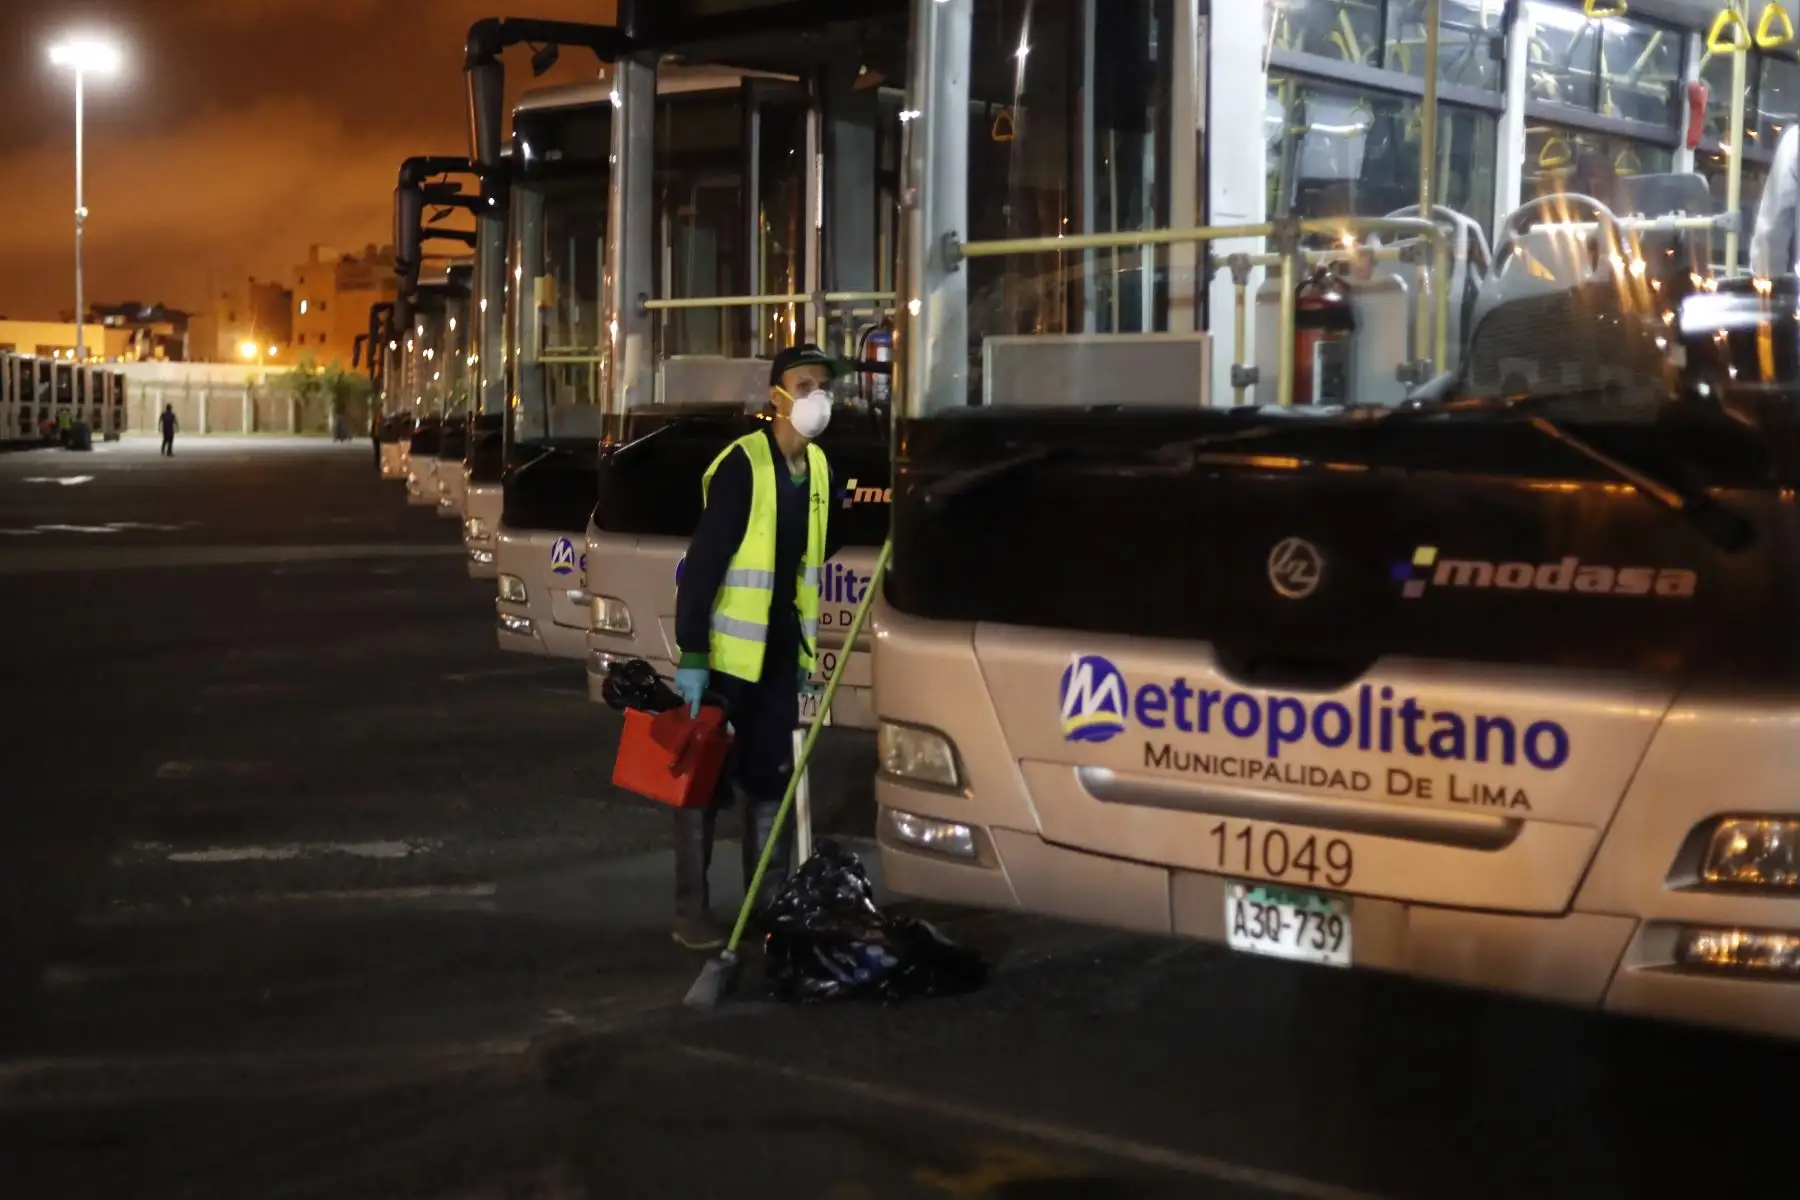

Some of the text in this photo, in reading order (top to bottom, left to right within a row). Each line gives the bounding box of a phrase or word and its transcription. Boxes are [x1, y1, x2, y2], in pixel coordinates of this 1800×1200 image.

[818, 563, 872, 604] lit
[1433, 556, 1697, 597] modasa
[1060, 654, 1570, 770] Metropolitano
[1143, 741, 1371, 793] MUNICIPALIDAD
[1449, 774, 1532, 811] LIMA
[1210, 821, 1354, 888] 11049
[1234, 900, 1343, 952] A3Q-739
